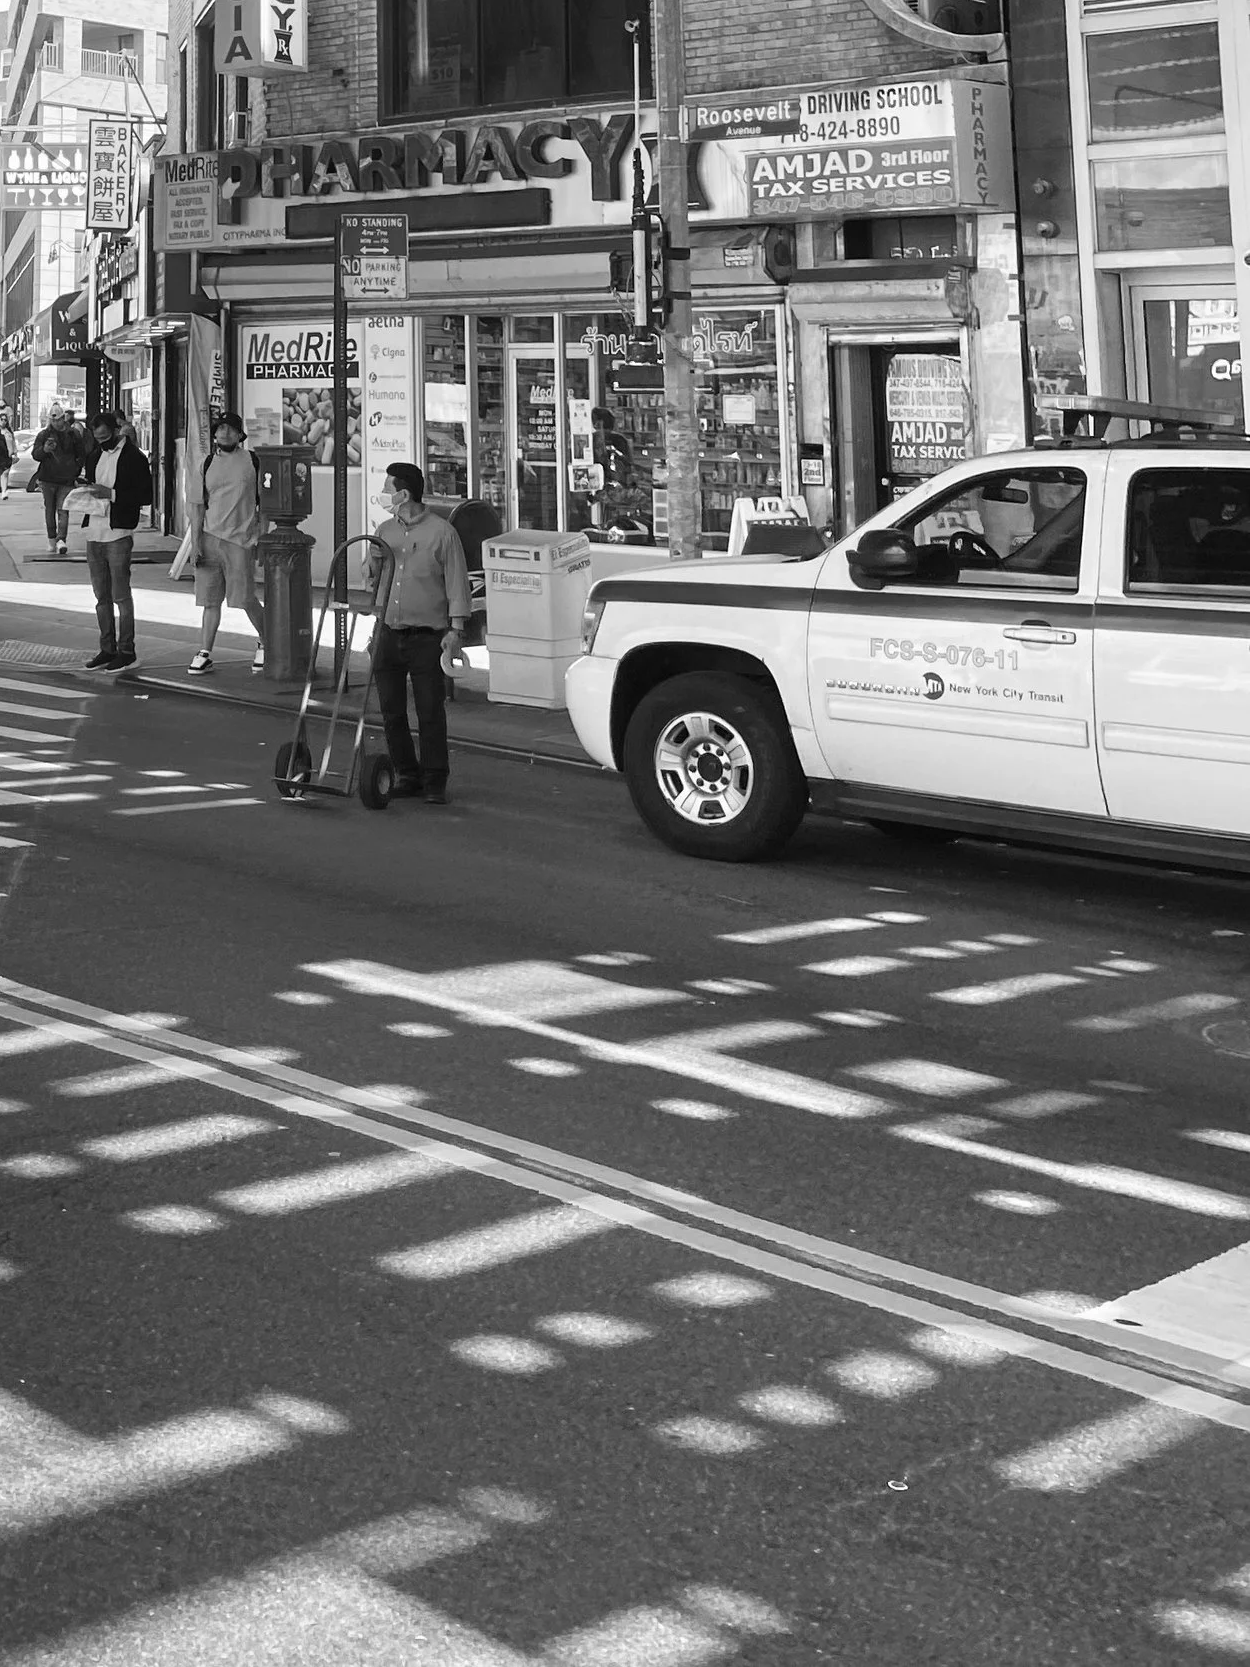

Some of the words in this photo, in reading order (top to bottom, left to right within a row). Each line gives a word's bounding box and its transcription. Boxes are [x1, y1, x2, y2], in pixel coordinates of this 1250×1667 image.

[807, 90, 871, 115] DRIVING
[875, 84, 943, 110] SCHOOL
[697, 100, 792, 125] Roosevelt
[725, 125, 762, 136] Avenue
[971, 87, 989, 205] PHARMACY
[115, 127, 127, 222] BAKERY
[165, 156, 218, 183] MedRite
[217, 114, 635, 226] PHARMACY
[752, 148, 873, 183] AMJAD
[880, 151, 908, 167] 3rd
[910, 149, 950, 165] Floor
[51, 171, 87, 185] LIQUO
[752, 181, 805, 198] TAX
[811, 169, 951, 194] SERVICES
[346, 218, 358, 228] NO
[361, 218, 403, 228] STANDING
[342, 258, 360, 274] NO
[365, 263, 402, 272] PARKING
[353, 276, 398, 287] ANYTIME
[368, 317, 405, 328] aetna
[248, 332, 358, 363] MedRie
[382, 347, 406, 359] Cigna
[253, 363, 351, 379] PHARMAC
[368, 390, 406, 400] Humana
[891, 422, 947, 444] AMJAD
[891, 445, 917, 458] TAX
[803, 468, 821, 476] 2nd
[869, 637, 1019, 671] FCS-S-076-11
[949, 683, 971, 694] New
[975, 685, 998, 697] York
[1002, 688, 1024, 702] City
[1029, 690, 1064, 704] Transit
